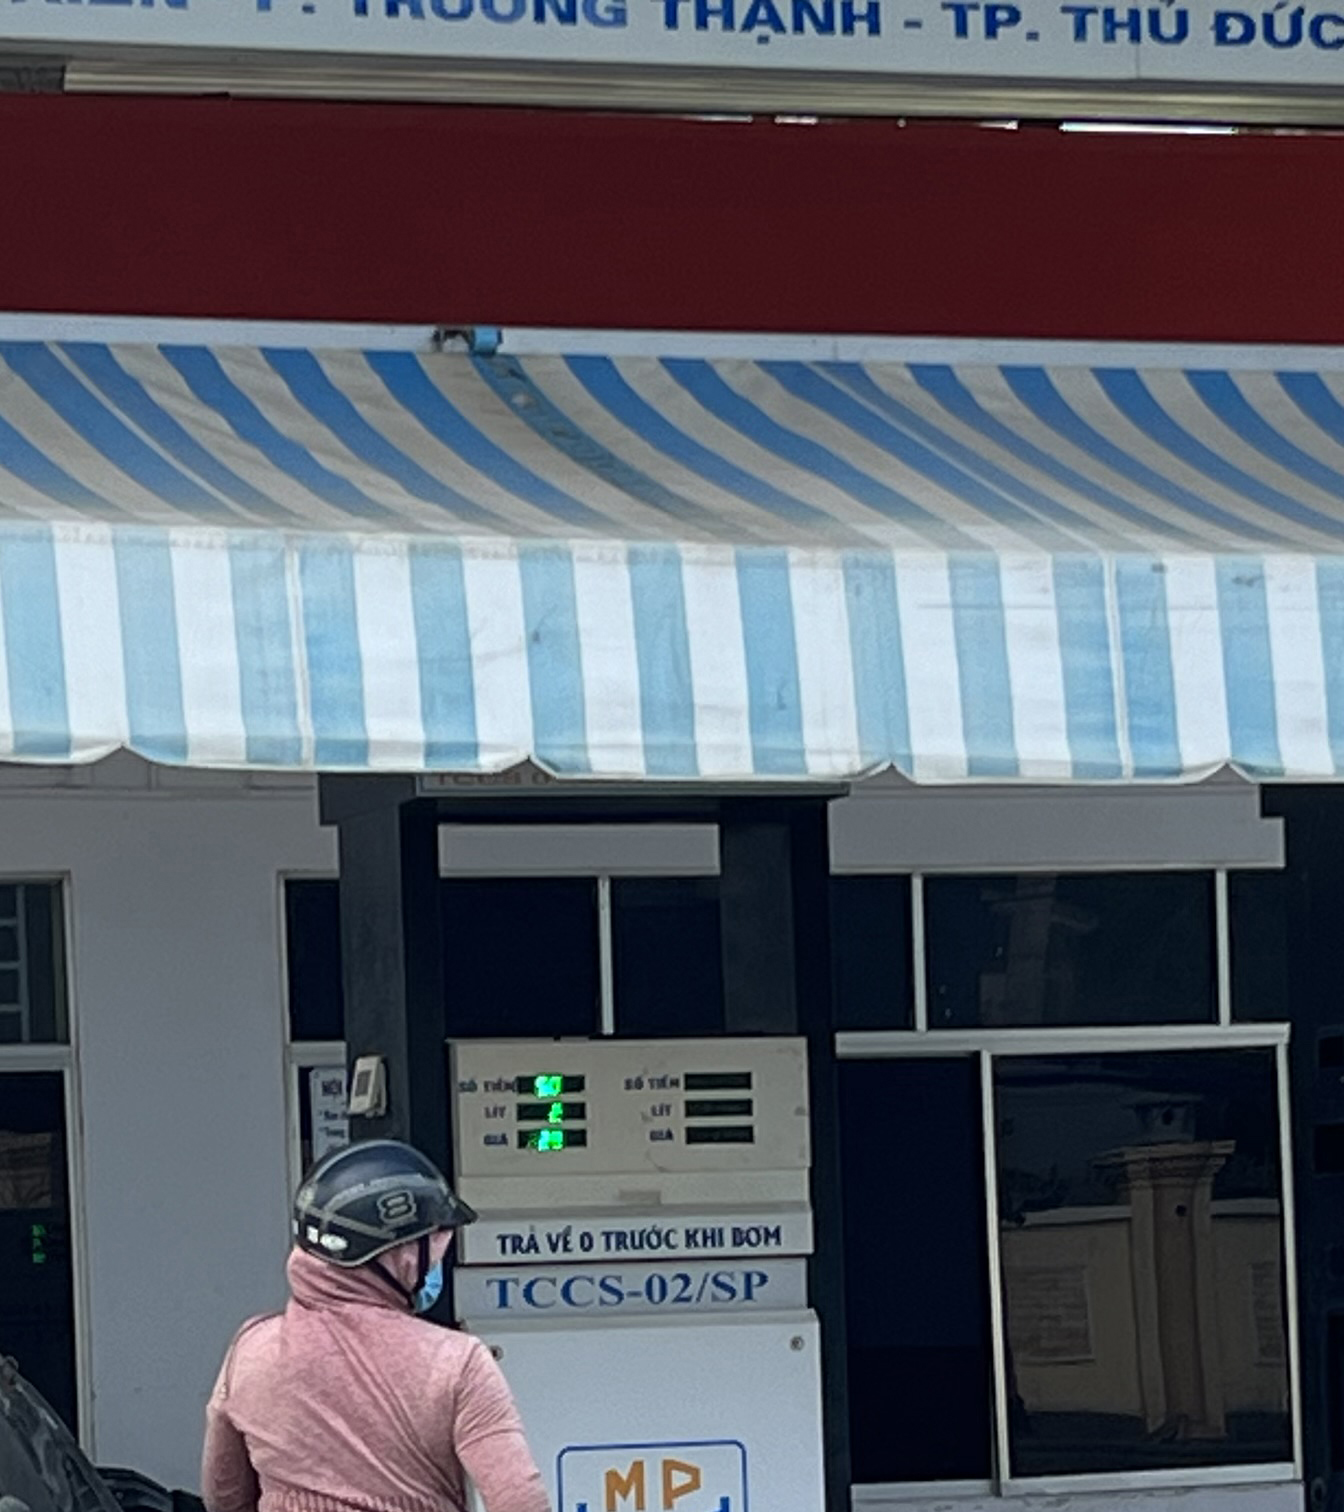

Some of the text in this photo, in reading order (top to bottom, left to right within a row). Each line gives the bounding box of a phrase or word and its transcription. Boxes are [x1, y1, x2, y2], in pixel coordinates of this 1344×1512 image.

[941, 1, 1039, 41] TP.
[601, 1223, 677, 1252] TRƯỚC
[684, 1227, 725, 1248] KHI
[731, 1224, 782, 1247] BƠM
[486, 1270, 769, 1309] TCCS-02/SP
